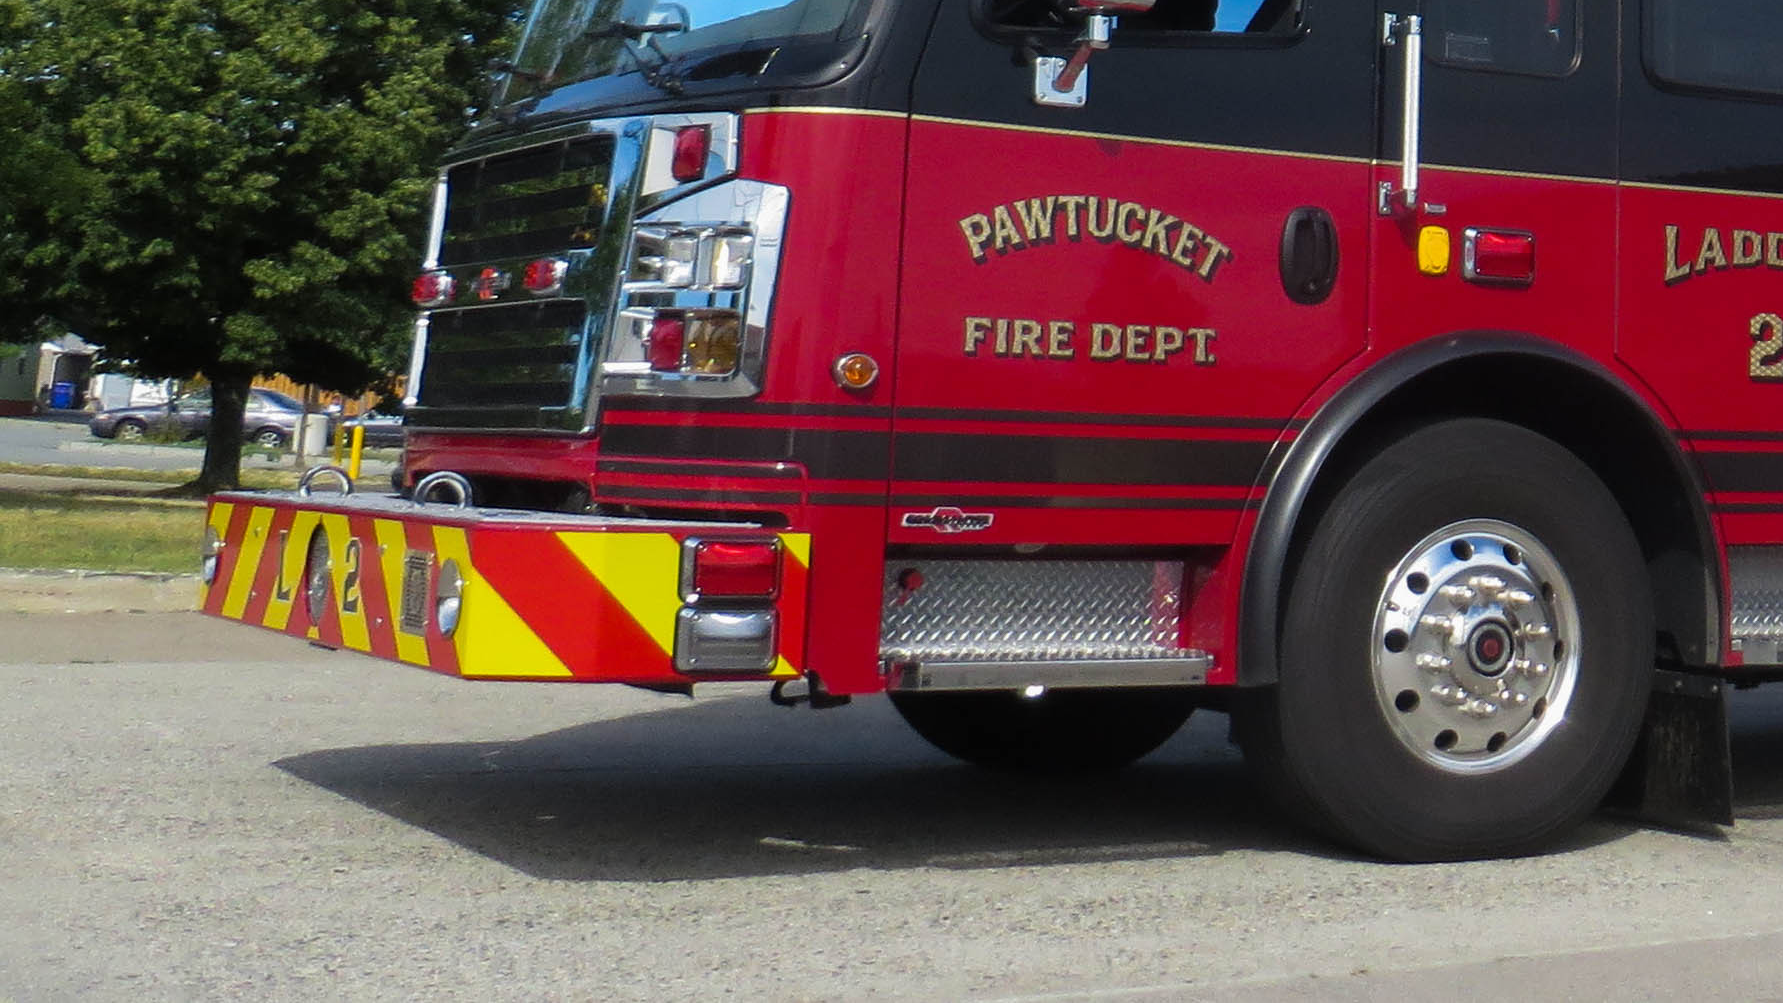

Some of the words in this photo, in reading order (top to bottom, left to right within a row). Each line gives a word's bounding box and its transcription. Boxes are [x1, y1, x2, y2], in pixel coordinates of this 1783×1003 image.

[959, 195, 1233, 283] PAWTUCKET
[963, 316, 1076, 358] FIRE
[1090, 322, 1218, 366] DEPT.
[342, 537, 362, 614] 2
